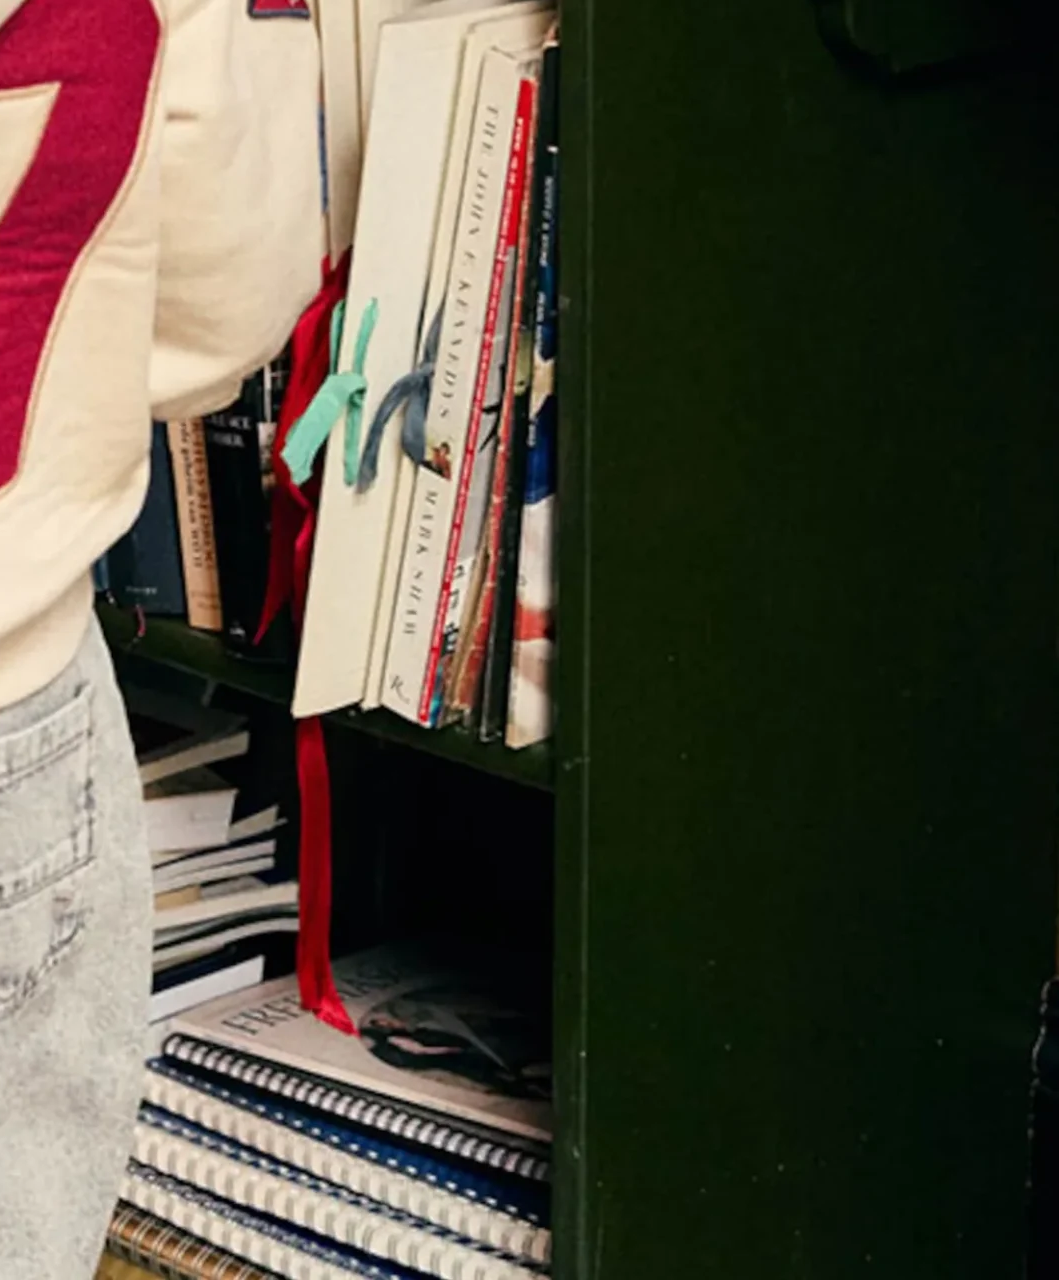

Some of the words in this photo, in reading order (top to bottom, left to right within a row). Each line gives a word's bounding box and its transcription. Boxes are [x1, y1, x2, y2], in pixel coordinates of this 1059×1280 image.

[481, 105, 499, 157] THE
[467, 167, 492, 238] JOHN
[416, 490, 439, 557] MARK
